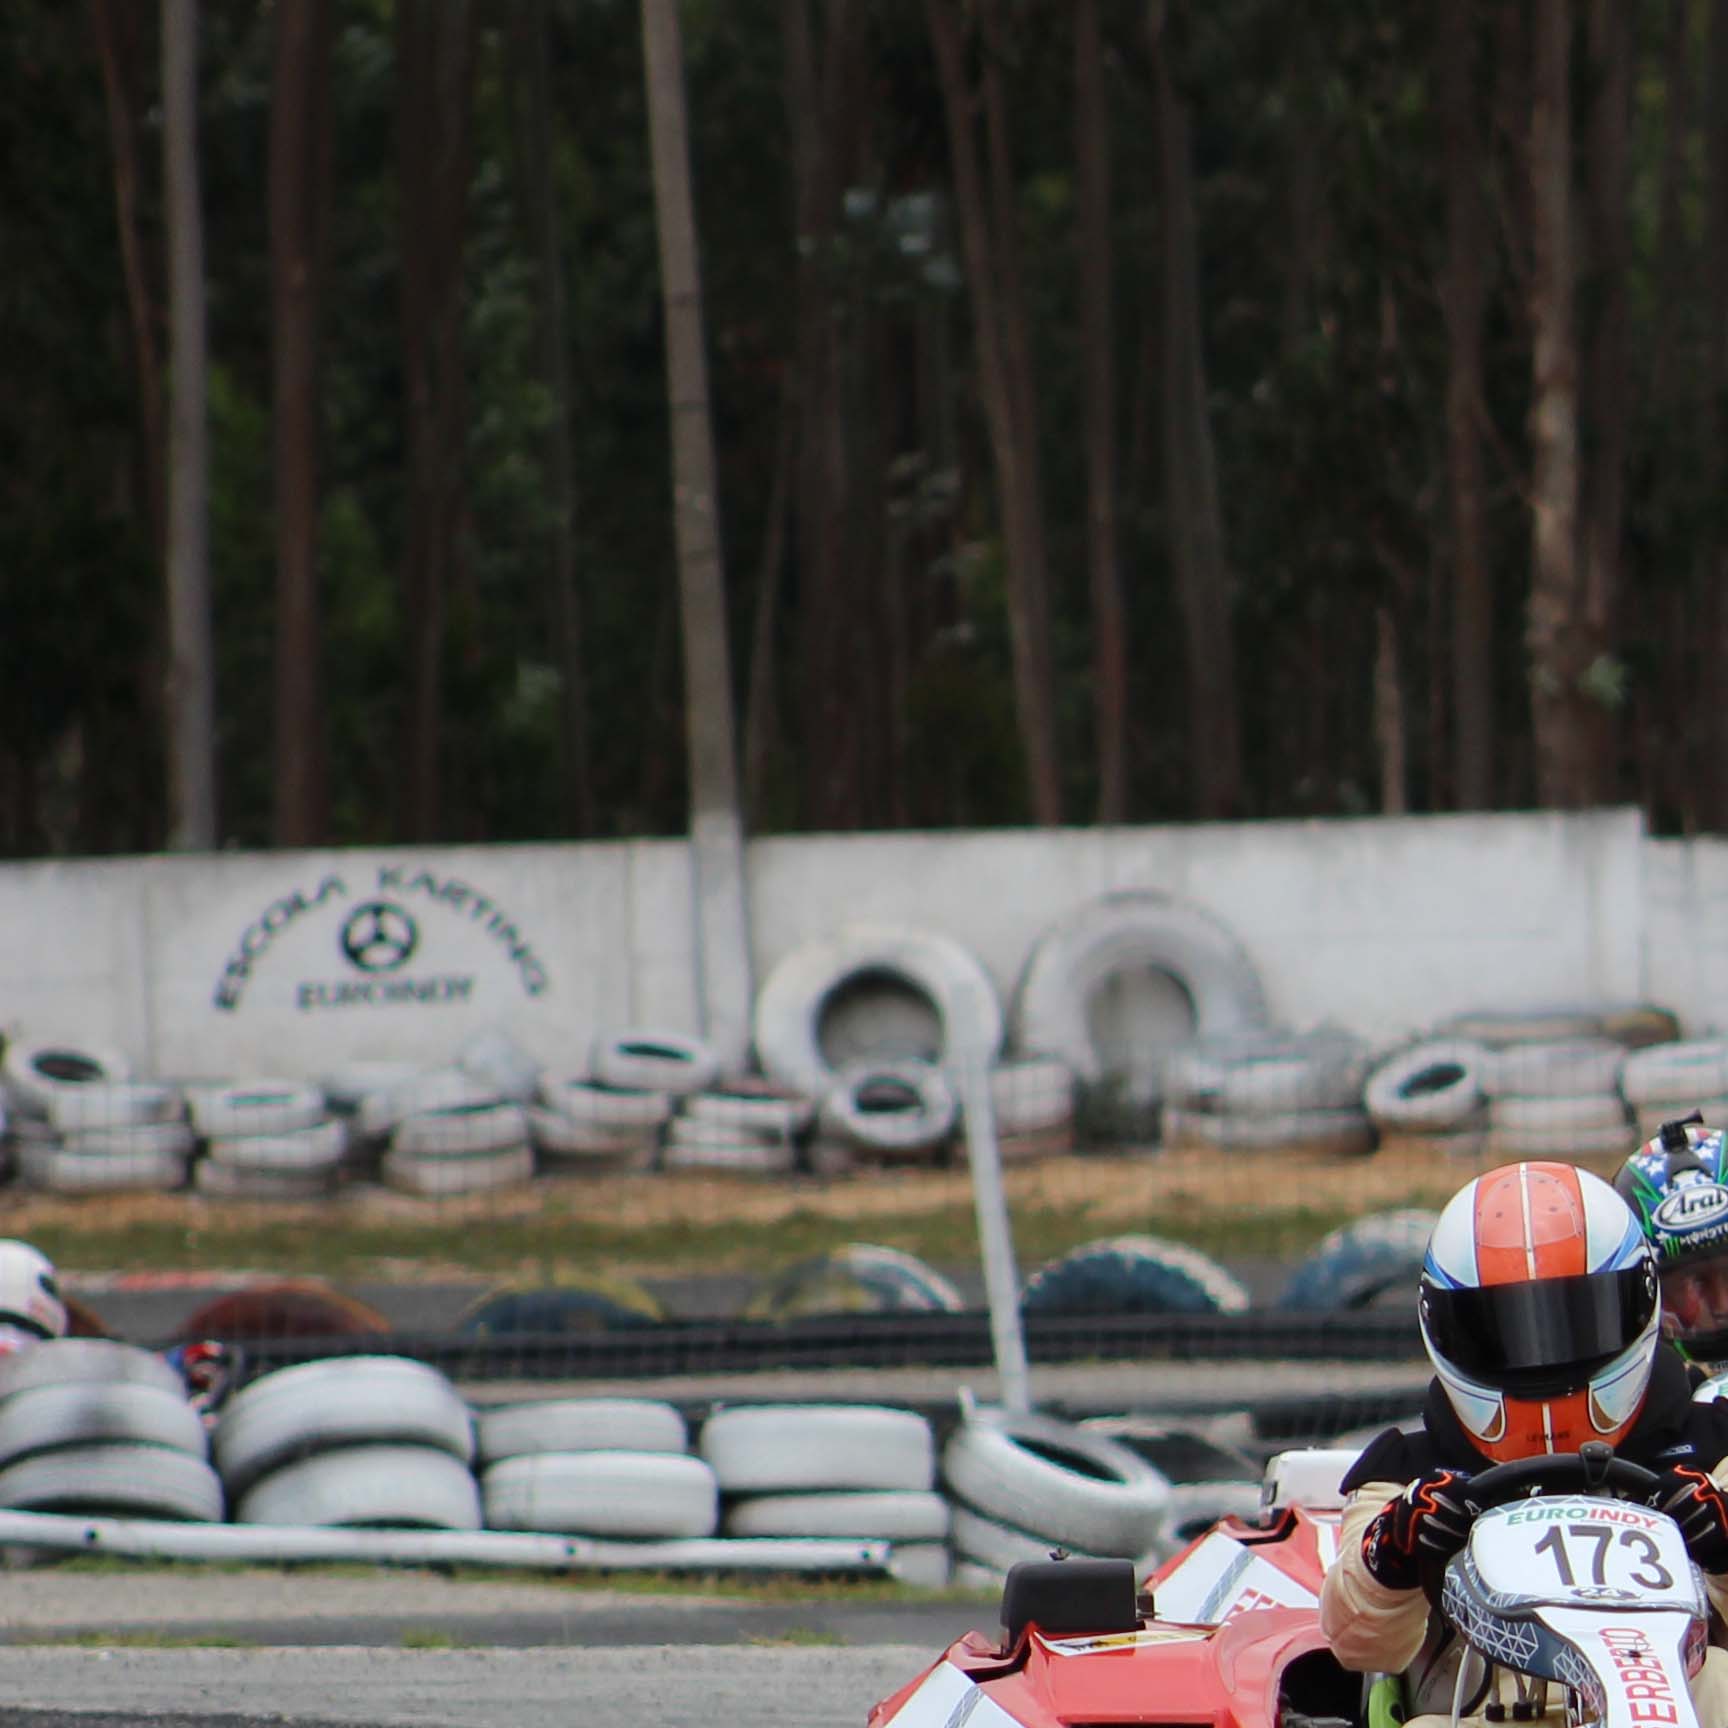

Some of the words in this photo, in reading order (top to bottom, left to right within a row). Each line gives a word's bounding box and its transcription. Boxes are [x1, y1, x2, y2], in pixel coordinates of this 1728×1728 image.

[214, 872, 348, 1010] ESCOLA
[377, 866, 549, 997] KARTING
[1507, 1506, 1660, 1529] EUROINDY
[1534, 1524, 1674, 1590] 173
